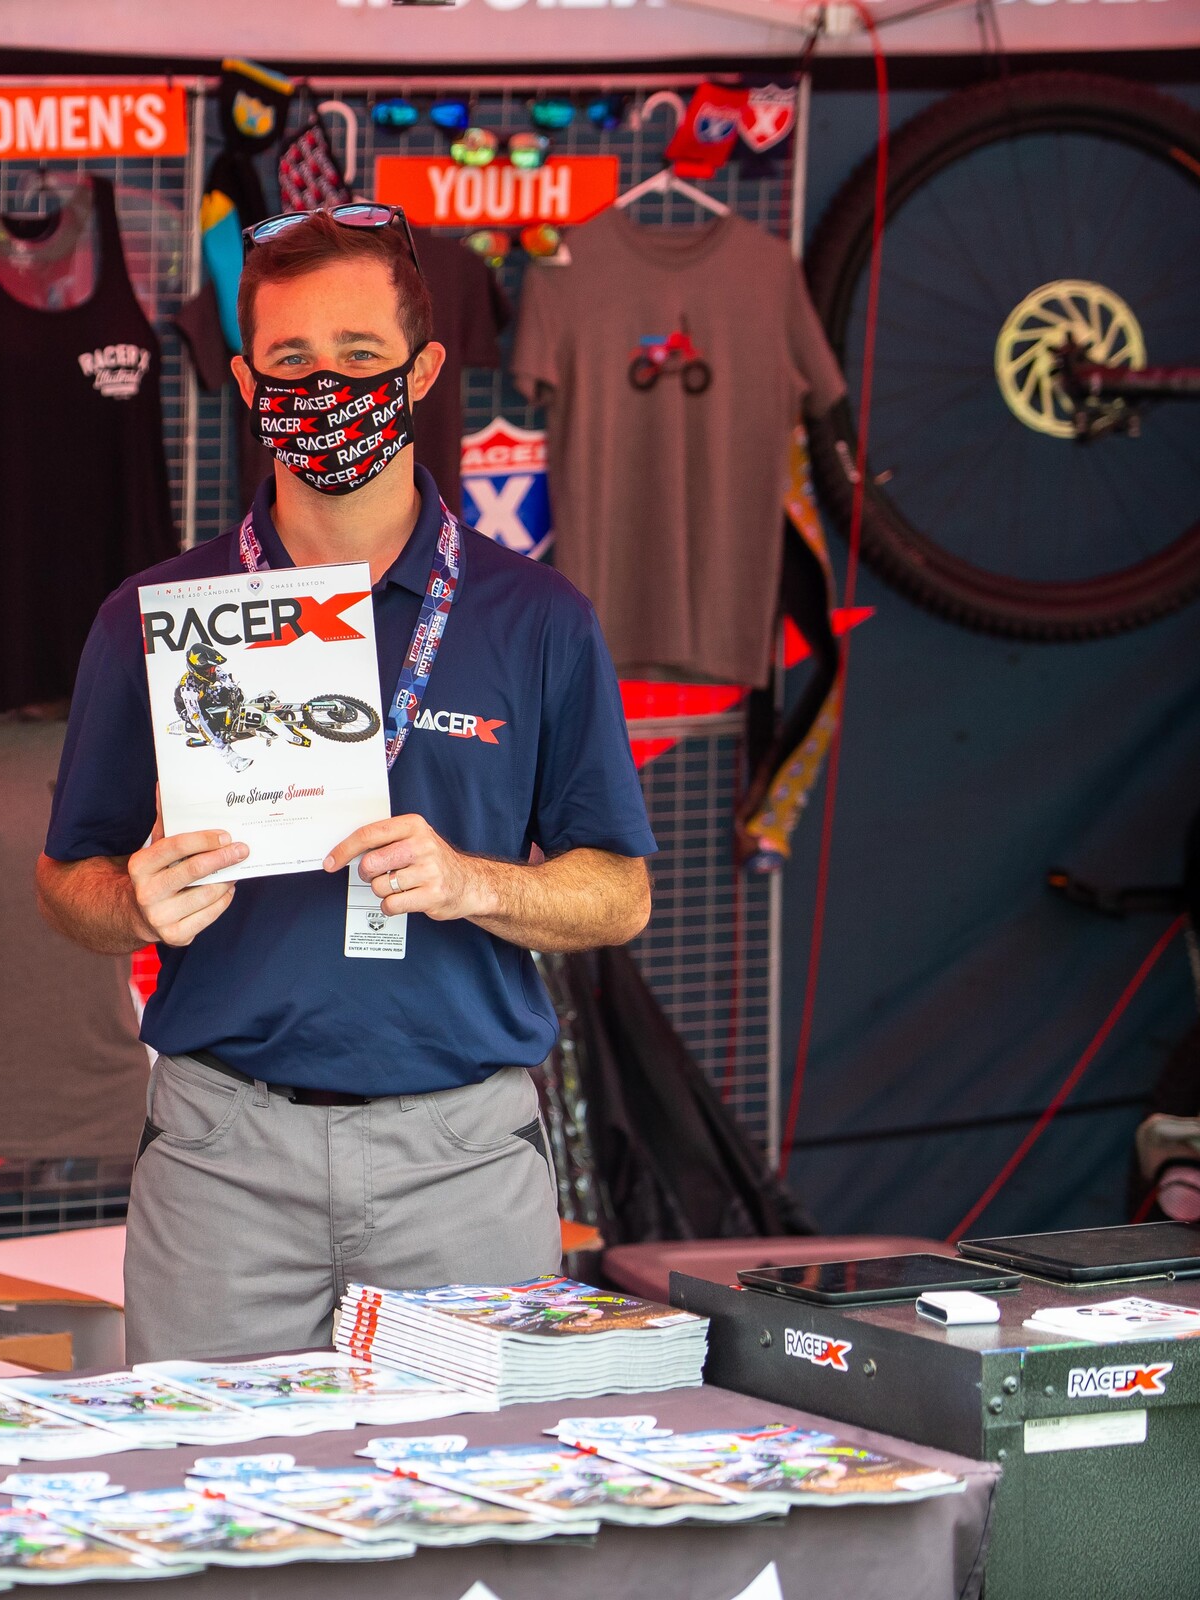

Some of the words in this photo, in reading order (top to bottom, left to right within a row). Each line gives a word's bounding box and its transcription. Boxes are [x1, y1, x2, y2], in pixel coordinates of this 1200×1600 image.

[427, 165, 570, 220] YOUTH
[464, 475, 536, 549] X
[157, 584, 212, 595] INSIDE
[204, 588, 240, 597] CANDIDATE
[410, 636, 422, 662] LUCAS
[419, 623, 427, 638] OIL
[416, 615, 442, 678] MOTOCROSS
[226, 790, 246, 807] One
[247, 787, 284, 804] Strange
[284, 783, 325, 801] Summer
